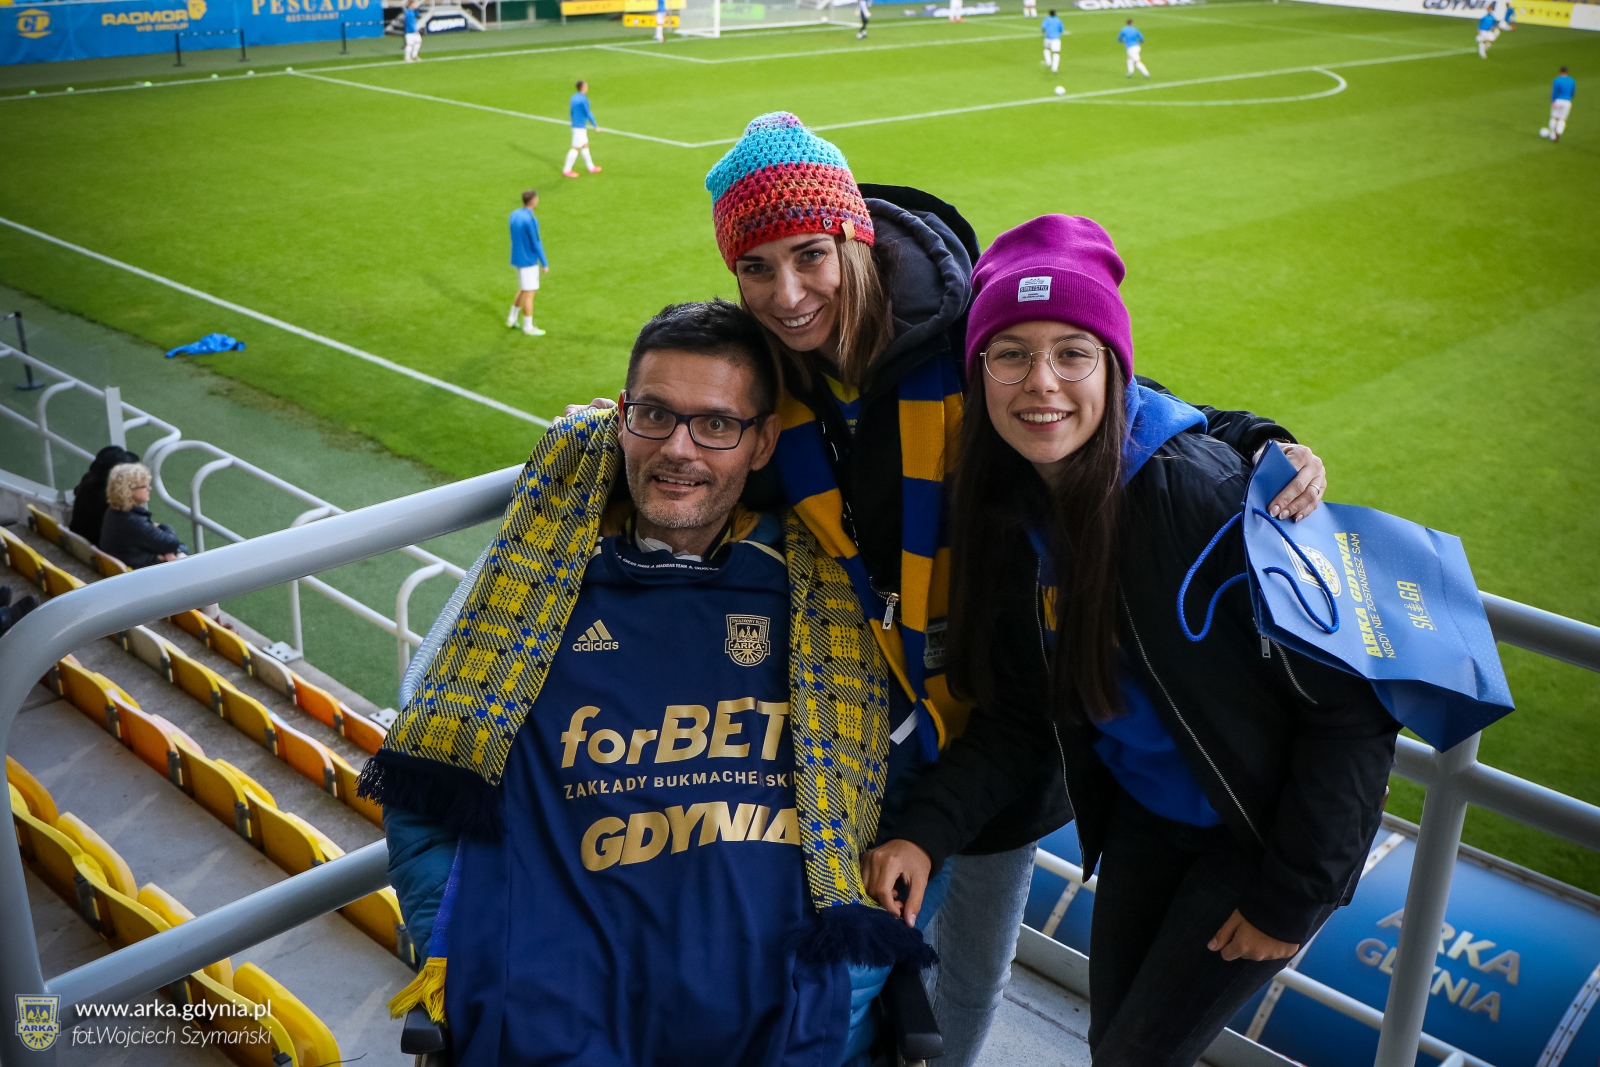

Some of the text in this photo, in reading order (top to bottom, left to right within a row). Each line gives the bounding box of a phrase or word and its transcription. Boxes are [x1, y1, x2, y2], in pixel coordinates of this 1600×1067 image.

[102, 9, 188, 26] RADMOR
[252, 0, 370, 15] PESCADO
[1334, 532, 1384, 658] ARKA GDYNIA
[1350, 533, 1396, 659] NIGDY NIE ZOSTANIESZ SAM
[572, 639, 619, 652] adidas
[733, 642, 762, 650] ARKA
[560, 696, 790, 769] forBET
[563, 775, 648, 800] ZAKŁADY
[580, 801, 801, 872] GDYNIA
[1355, 937, 1501, 1023] GNIA
